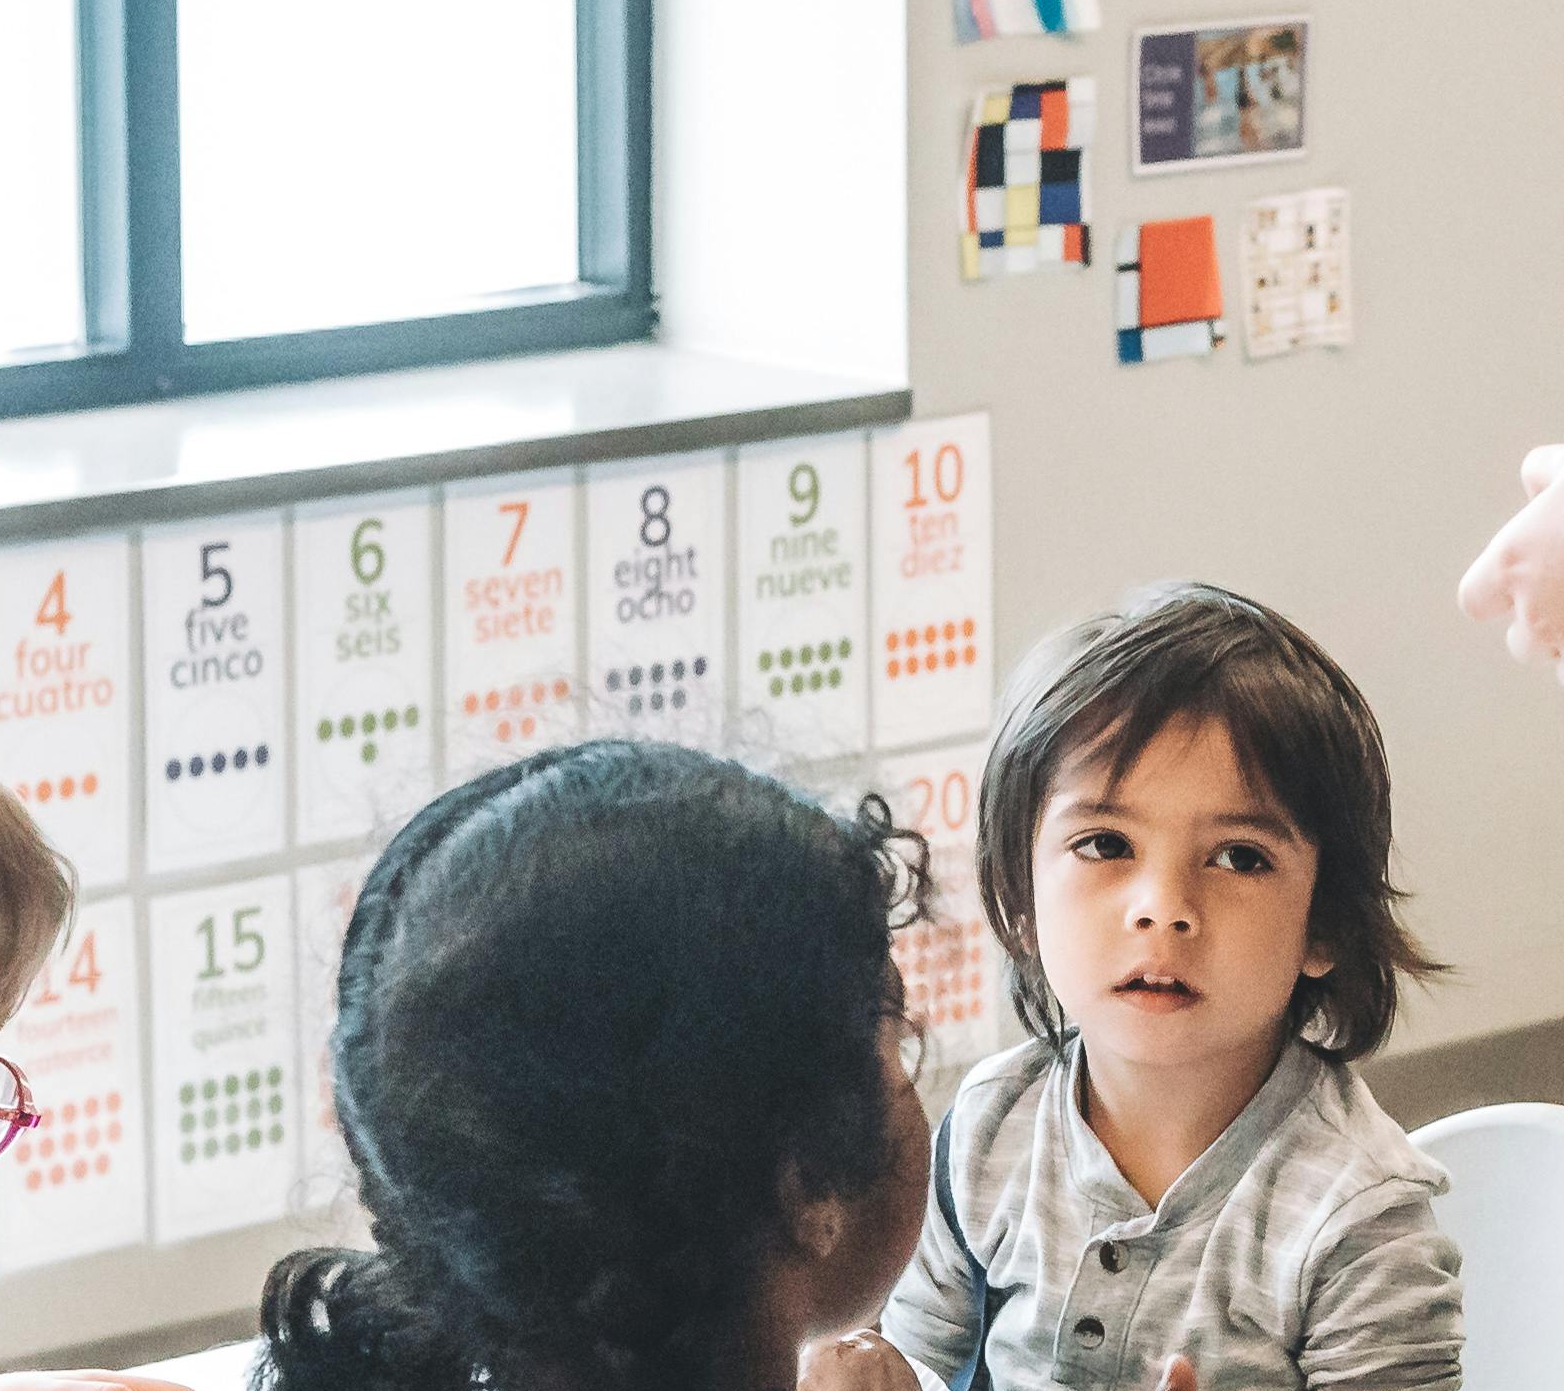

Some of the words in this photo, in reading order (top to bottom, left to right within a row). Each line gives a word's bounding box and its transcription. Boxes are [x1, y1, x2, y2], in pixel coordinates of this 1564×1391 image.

[789, 464, 821, 526] 9
[903, 443, 964, 507] 10
[499, 502, 529, 567] 7
[641, 485, 672, 546] 8
[909, 511, 958, 543] ten
[351, 518, 387, 585] 6
[771, 527, 839, 559] nine
[899, 546, 963, 580] diez
[200, 541, 234, 608] 5
[464, 567, 563, 609] seven
[614, 546, 697, 598] eight
[756, 560, 852, 600] nueve
[35, 569, 73, 635] 4
[345, 591, 393, 623] six
[474, 603, 554, 644] siete
[617, 584, 695, 624] ocho
[185, 607, 249, 655] five
[336, 624, 401, 662] seis
[15, 637, 89, 679] four
[170, 645, 264, 689] cinco
[909, 768, 970, 836] 20
[196, 906, 267, 981] 15
[32, 930, 103, 1006] 14
